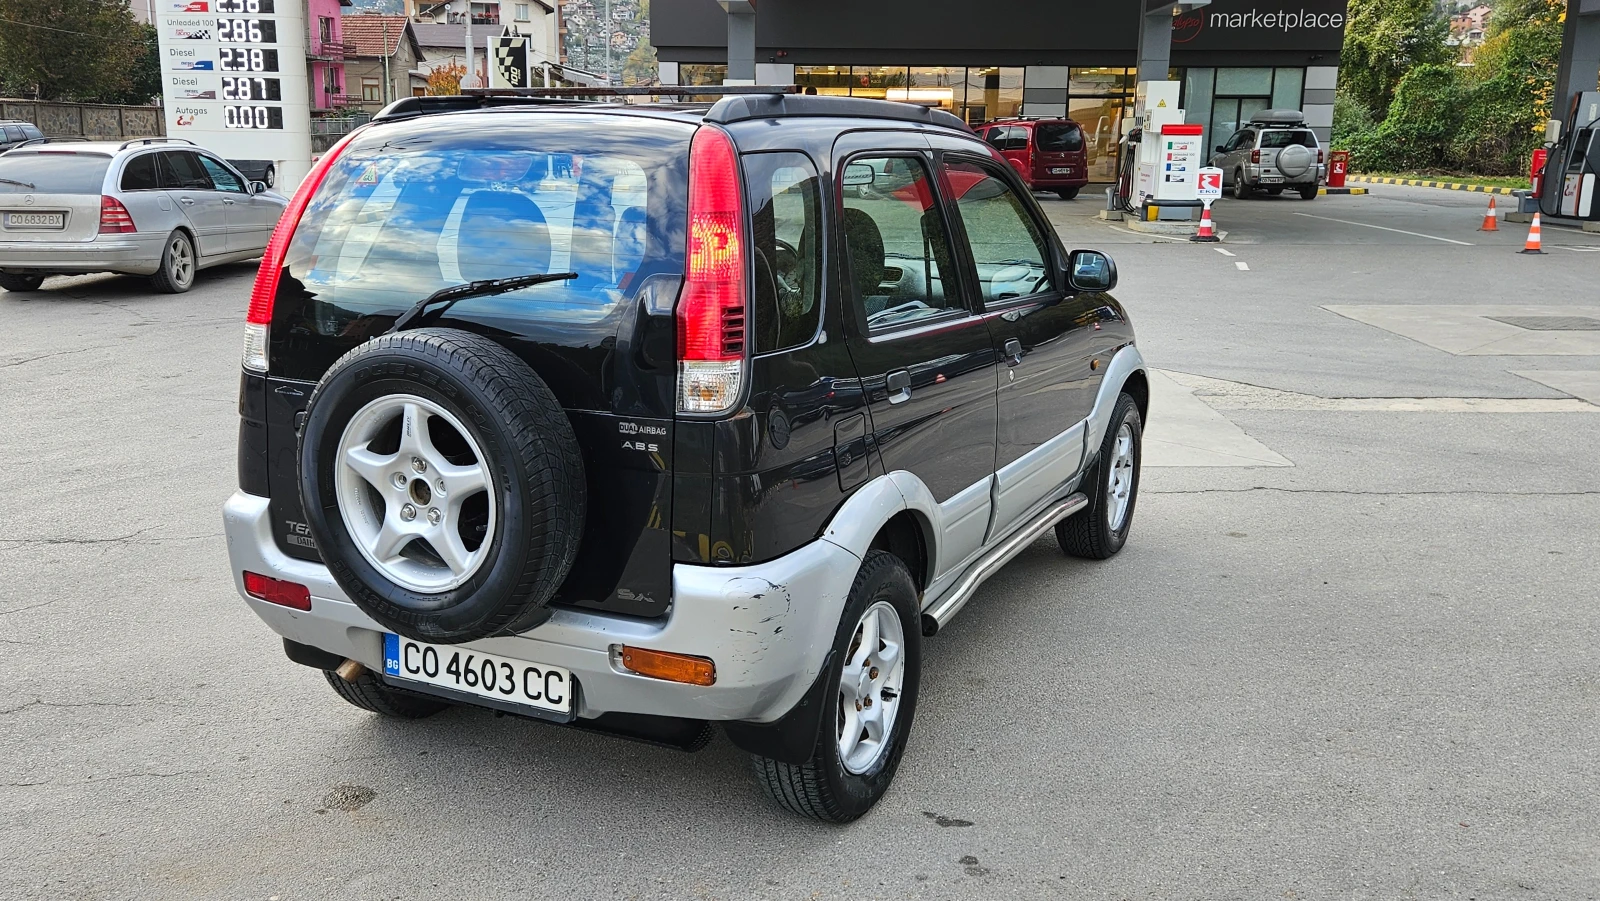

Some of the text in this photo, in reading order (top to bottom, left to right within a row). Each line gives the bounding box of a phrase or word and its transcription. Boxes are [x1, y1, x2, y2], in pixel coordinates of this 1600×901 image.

[202, 19, 214, 27] 100
[1210, 9, 1343, 32] marketplace
[218, 19, 262, 43] 2.86
[170, 48, 195, 57] Diesel
[220, 48, 264, 72] 2.38
[172, 77, 198, 86] Diesel
[510, 66, 519, 85] 100
[223, 78, 267, 100] 2.87
[175, 106, 208, 116] Autogas
[224, 106, 268, 129] 0.00
[10, 215, 61, 225] CO 6832 BX
[619, 422, 667, 435] DUAL AIRBAG
[386, 658, 399, 670] BG
[404, 642, 563, 704] CO 4603 CC
